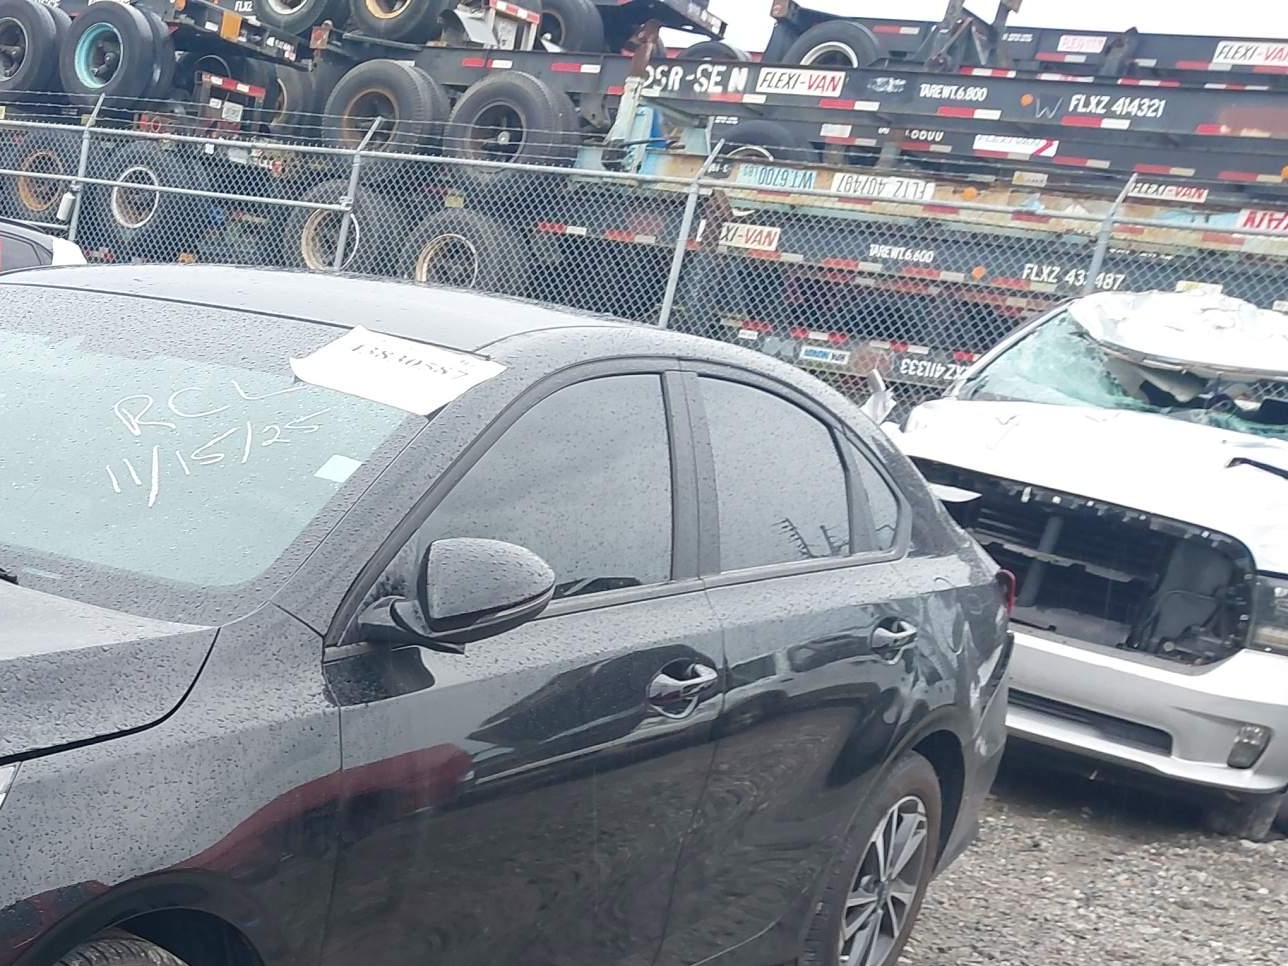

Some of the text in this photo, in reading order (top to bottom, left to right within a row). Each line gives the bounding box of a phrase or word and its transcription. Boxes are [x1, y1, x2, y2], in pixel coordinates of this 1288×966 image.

[759, 70, 843, 94] FLEXI-VAN
[1068, 94, 1167, 118] FLXZ 414321
[893, 180, 930, 200] FLTZ
[719, 224, 778, 247] XI-VAN
[1022, 263, 1126, 290] FLXZ 43487
